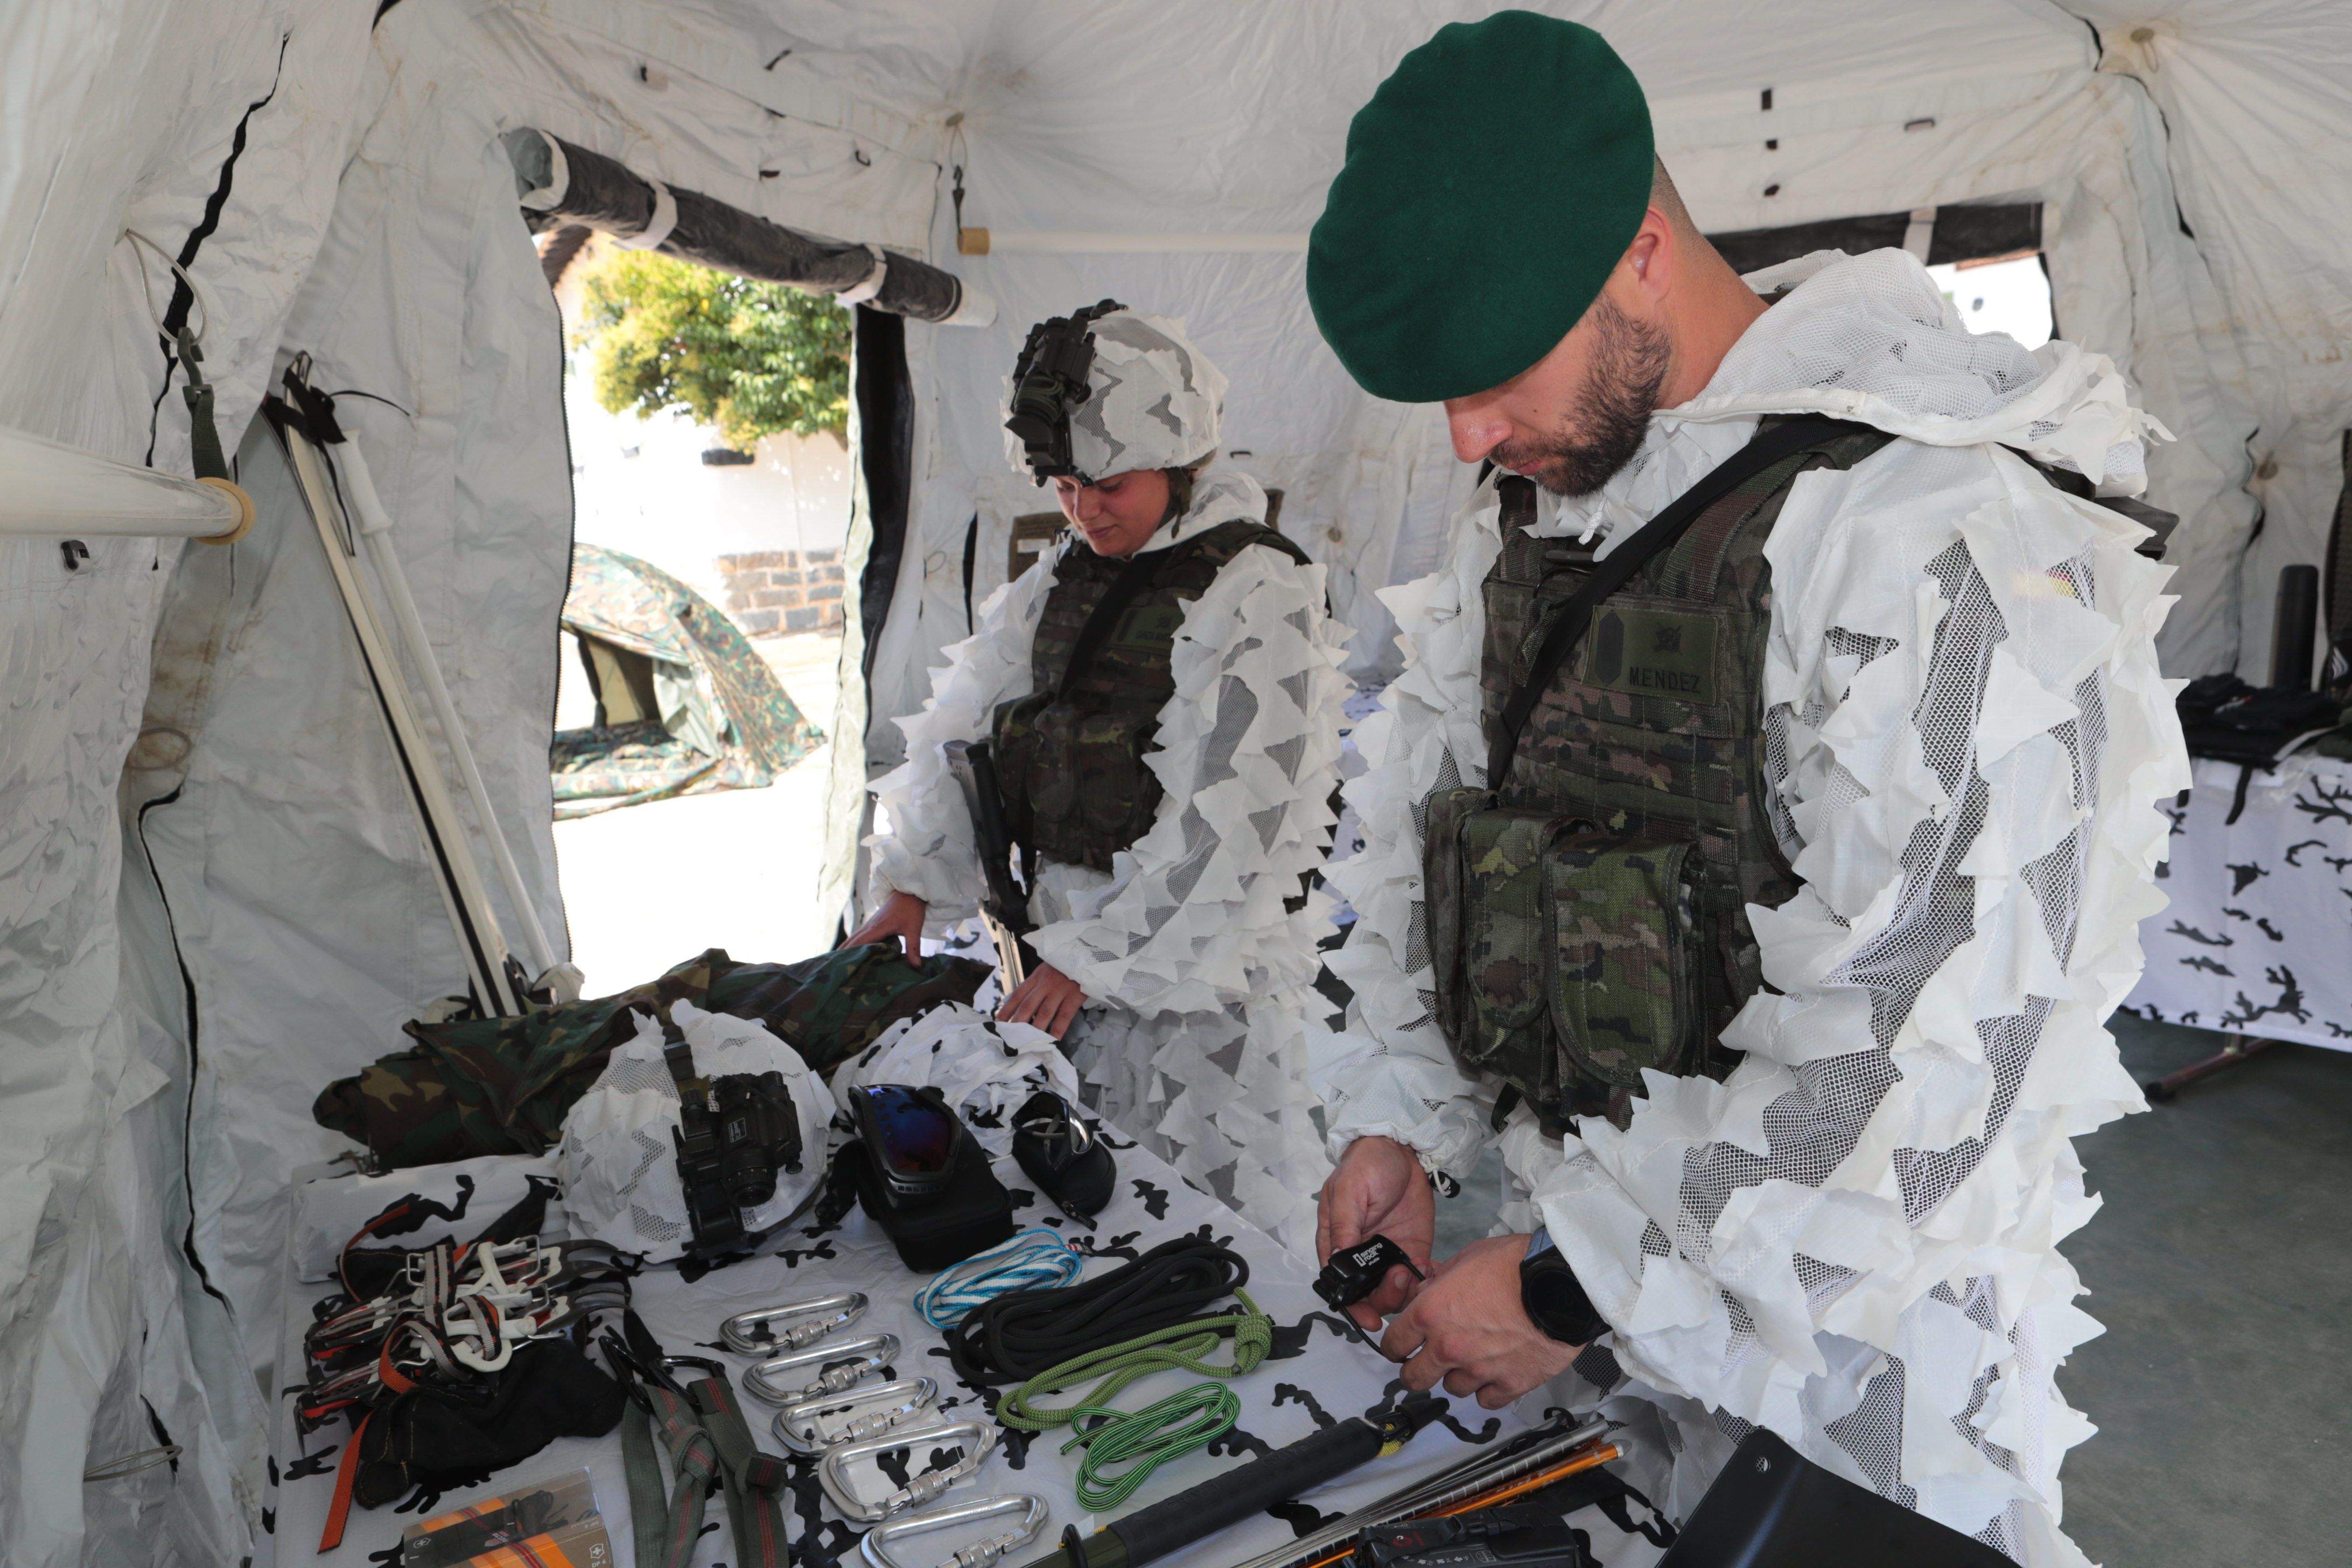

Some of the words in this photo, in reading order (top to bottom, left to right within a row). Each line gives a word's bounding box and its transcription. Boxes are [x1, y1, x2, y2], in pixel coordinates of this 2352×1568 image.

[1629, 667, 1701, 694] MENDEZ
[1361, 1243, 1382, 1258] singing
[1364, 1251, 1378, 1262] rock
[591, 1560, 601, 1568] DP
